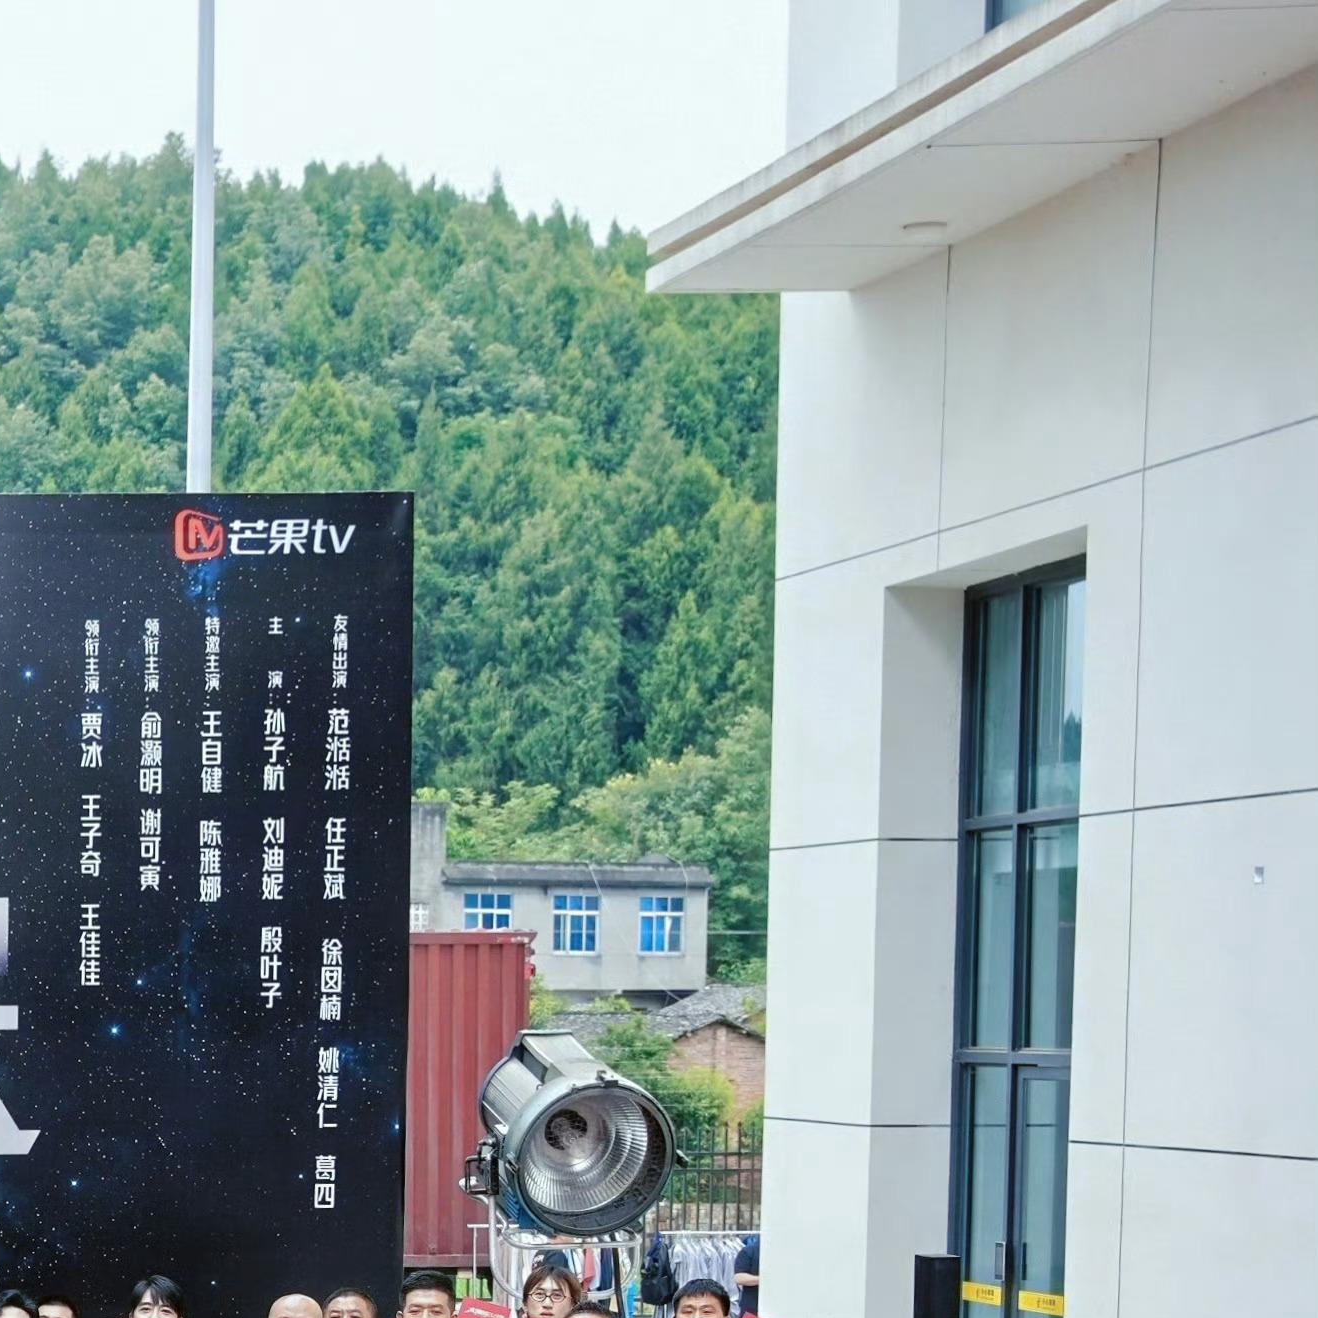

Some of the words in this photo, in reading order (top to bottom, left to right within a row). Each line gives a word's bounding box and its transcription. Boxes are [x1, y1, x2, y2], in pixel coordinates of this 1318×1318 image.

[228, 518, 356, 555] 芒果tv
[80, 712, 103, 768] 贾冰
[139, 712, 162, 794] 俞灏明
[200, 711, 223, 793] 王自健
[263, 708, 285, 791] 孙子航
[325, 708, 351, 791] 范湉湉
[79, 795, 102, 877] 王子奇
[139, 808, 162, 891] 谢可寅
[199, 820, 223, 902] 陈雅娜
[262, 817, 284, 900] 刘迪妮
[323, 817, 346, 900] 任正斌
[79, 903, 101, 987] 王佳佳
[260, 926, 282, 1008] 殷叶子
[320, 938, 342, 1021] 徐囡楠
[316, 1047, 339, 1129] 姚清仁
[314, 1155, 336, 1209] 葛四
